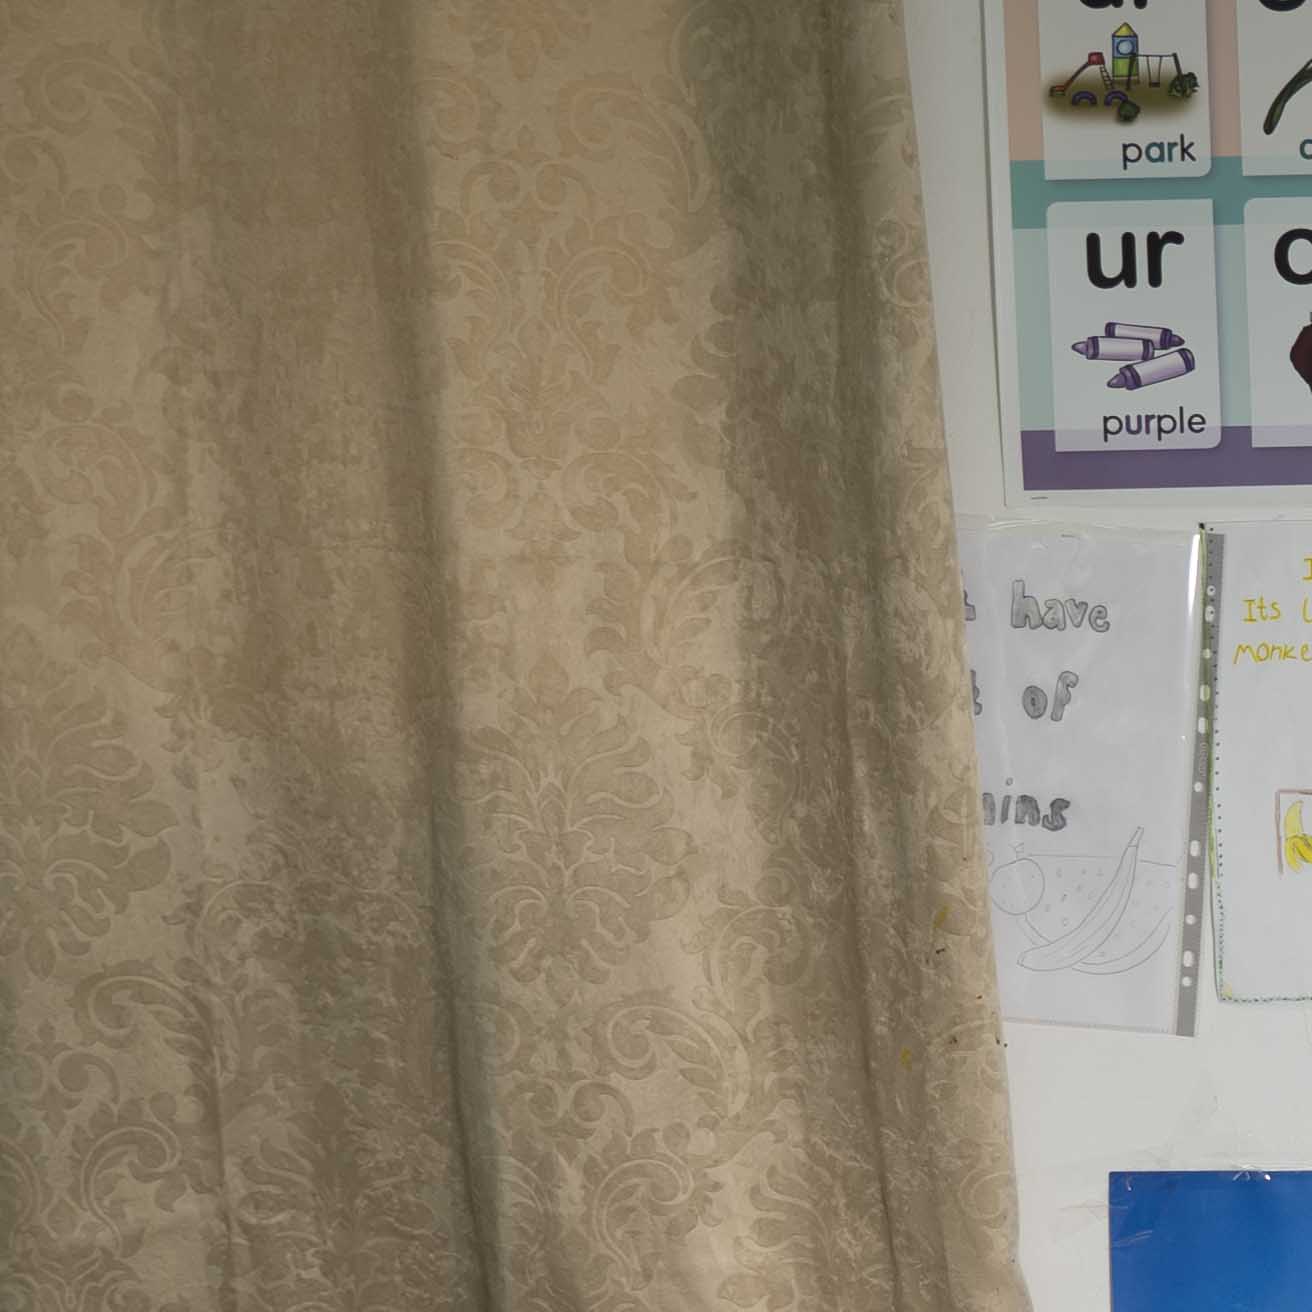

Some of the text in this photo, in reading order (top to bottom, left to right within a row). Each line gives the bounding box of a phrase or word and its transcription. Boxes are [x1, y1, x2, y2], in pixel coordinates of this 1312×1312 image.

[1121, 134, 1196, 165] park
[1086, 231, 1184, 289] ur
[1103, 406, 1206, 437] purple
[1010, 580, 1110, 633] have
[1243, 596, 1281, 624] Its
[1022, 671, 1079, 722] of
